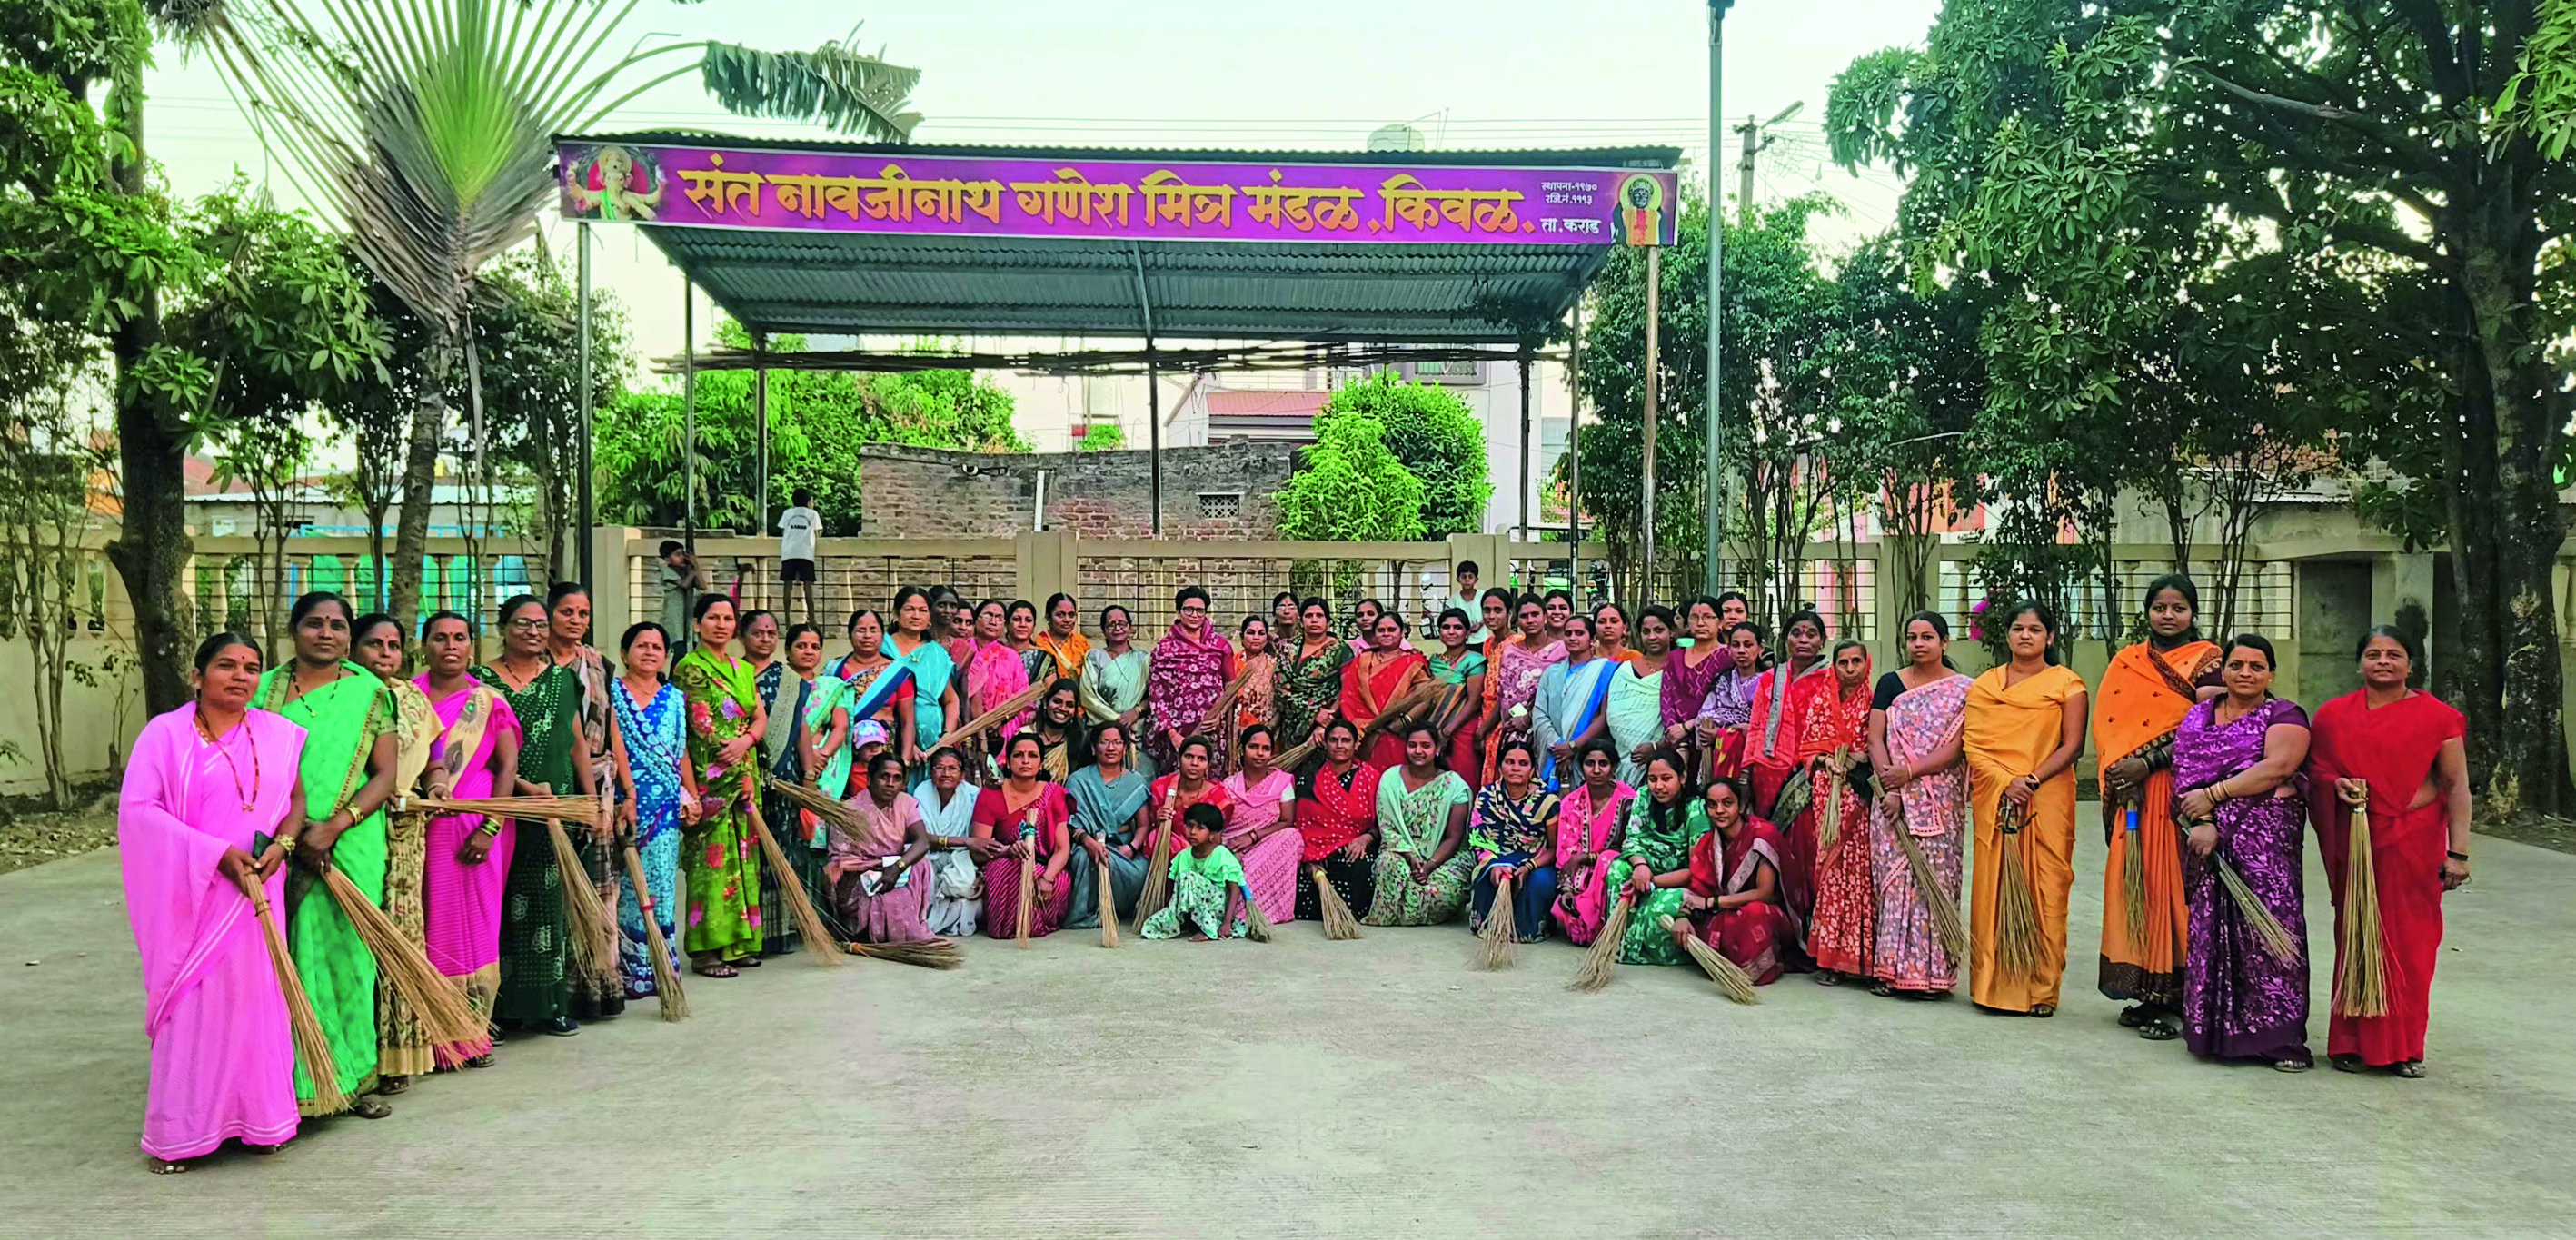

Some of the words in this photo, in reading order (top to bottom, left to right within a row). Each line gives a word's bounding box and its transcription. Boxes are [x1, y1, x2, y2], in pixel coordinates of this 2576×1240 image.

[677, 153, 766, 223] संत
[765, 164, 1006, 224] नावजीनाथ
[1009, 167, 1135, 229] गणेश
[1138, 169, 1238, 229] मित्र
